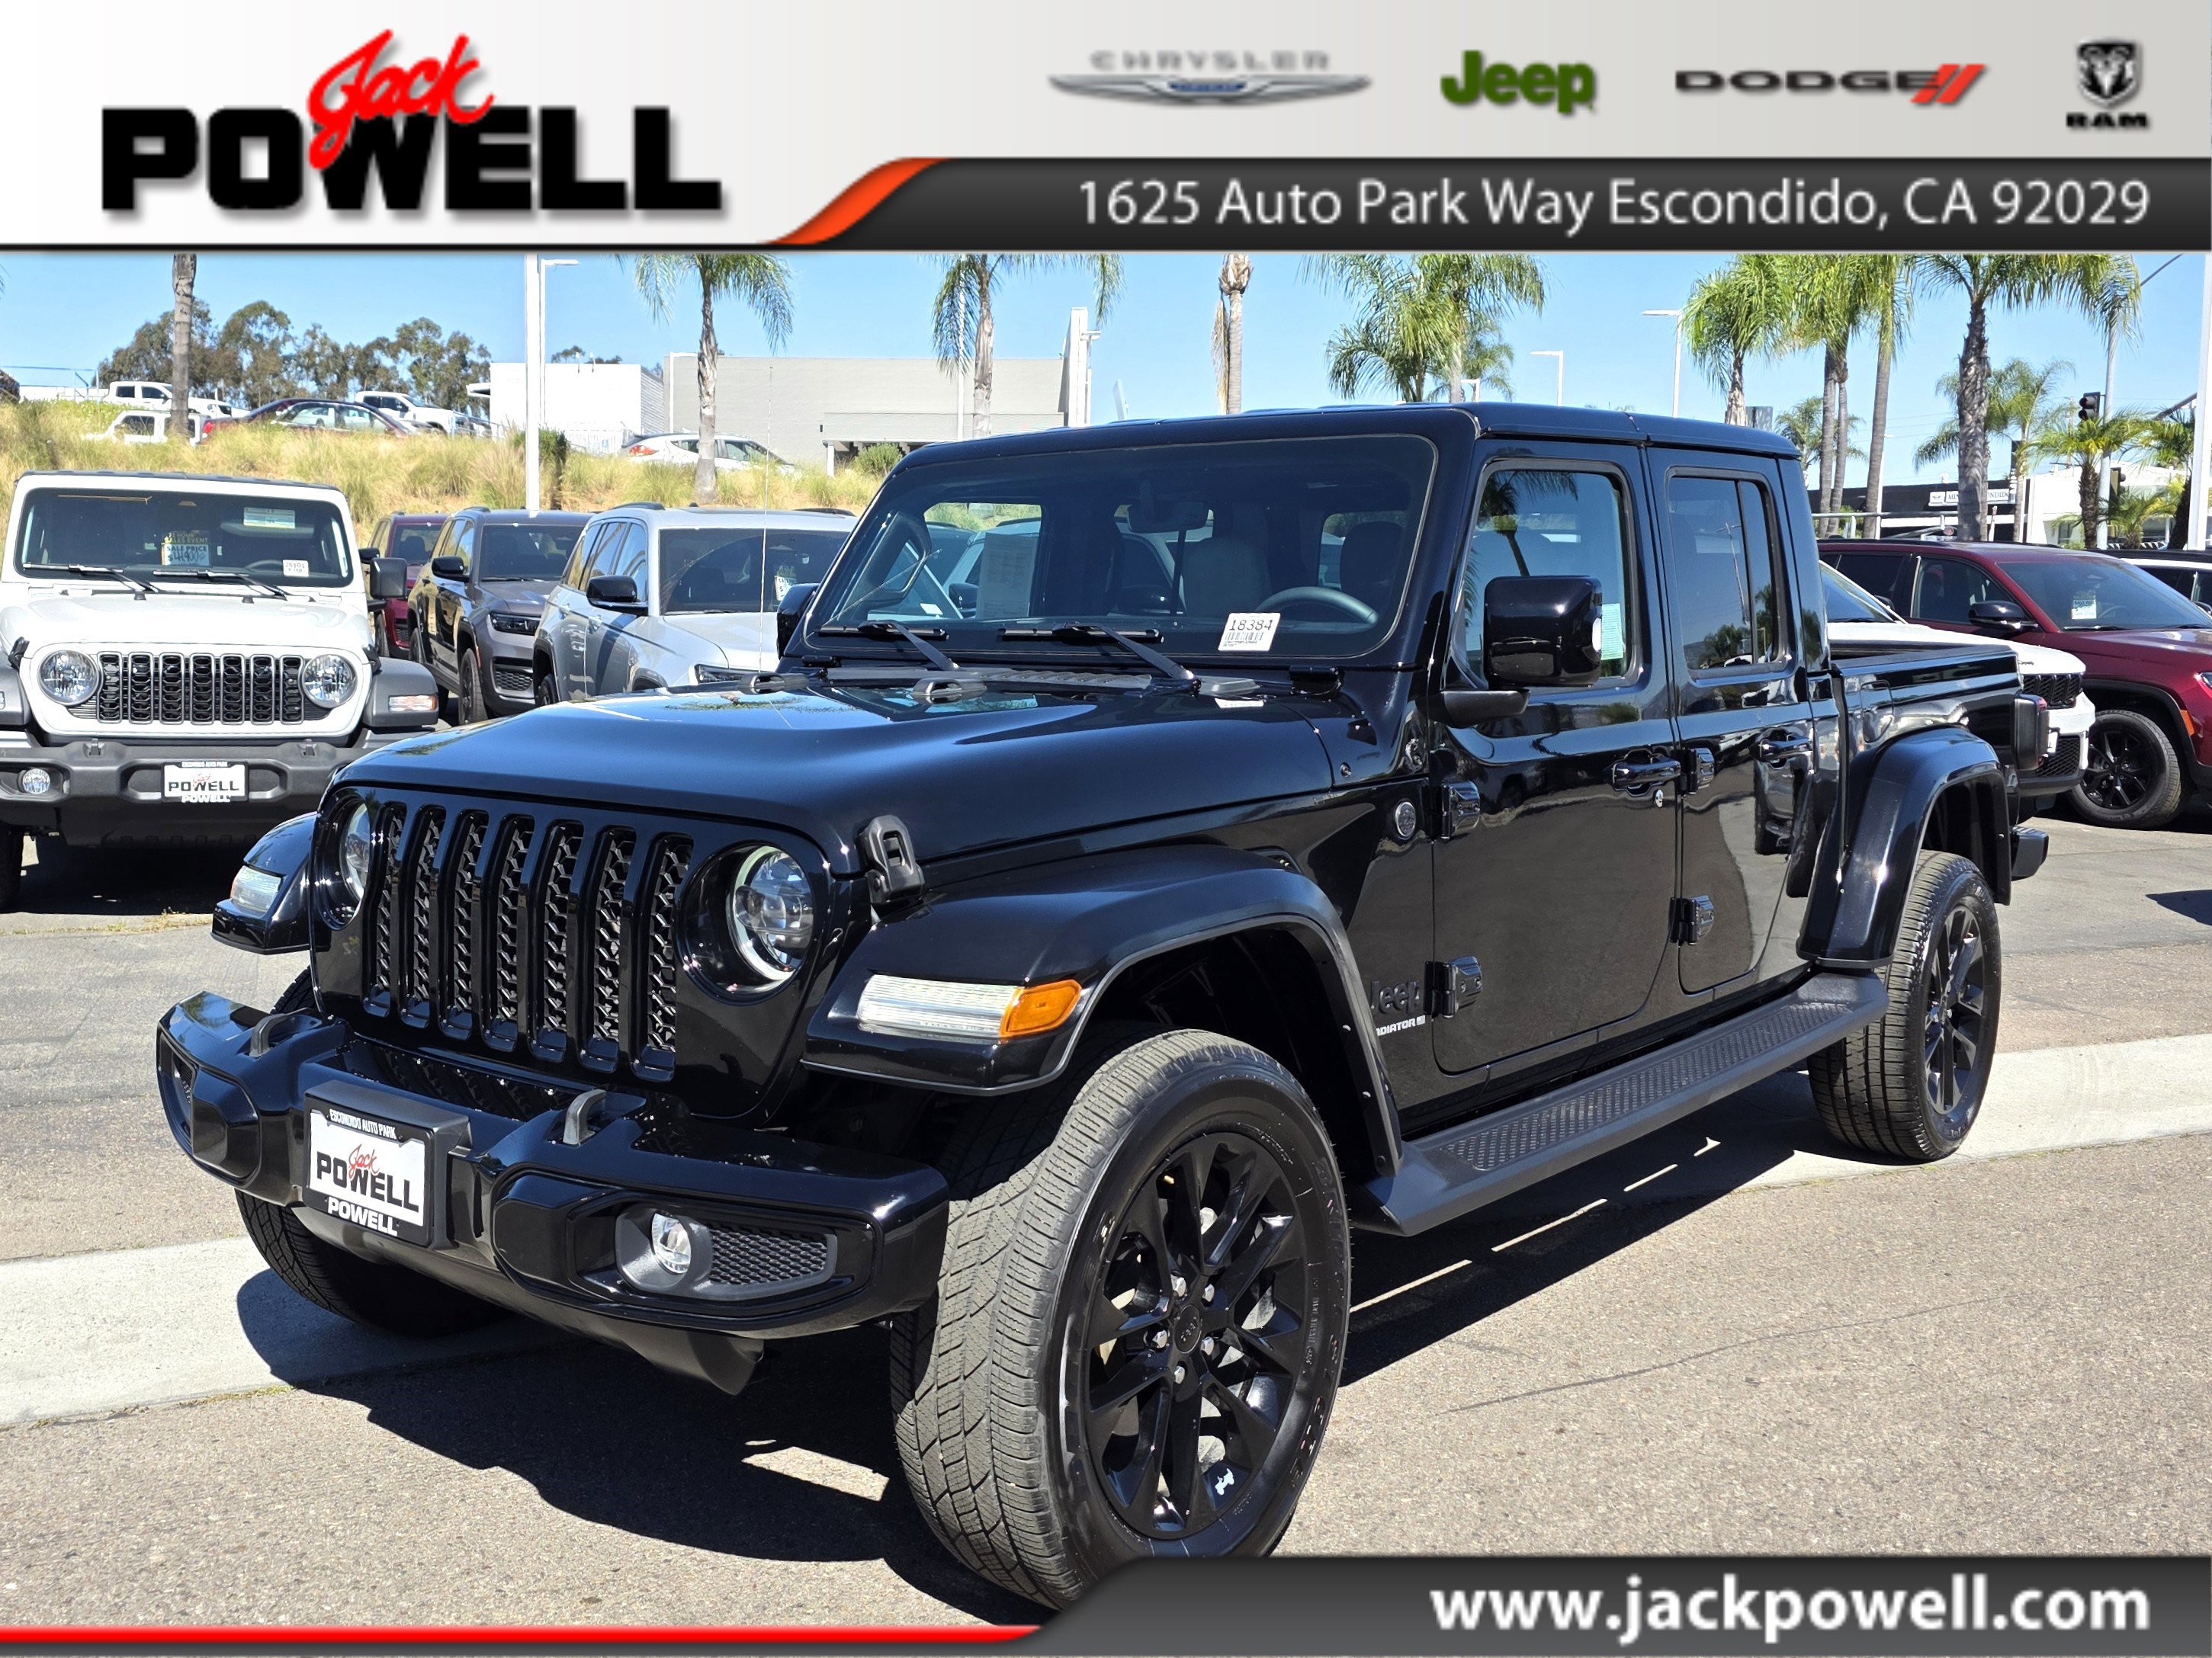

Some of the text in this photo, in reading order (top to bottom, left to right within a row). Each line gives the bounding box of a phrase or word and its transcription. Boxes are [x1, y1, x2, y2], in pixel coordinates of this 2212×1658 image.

[1228, 619, 1274, 631] 18384
[168, 781, 240, 792] POWELL
[329, 1108, 396, 1140] ESCONDIDO AUTO PARK
[348, 1143, 380, 1179] Jack
[316, 1151, 419, 1213] POWELL
[327, 1196, 398, 1236] POWELL
